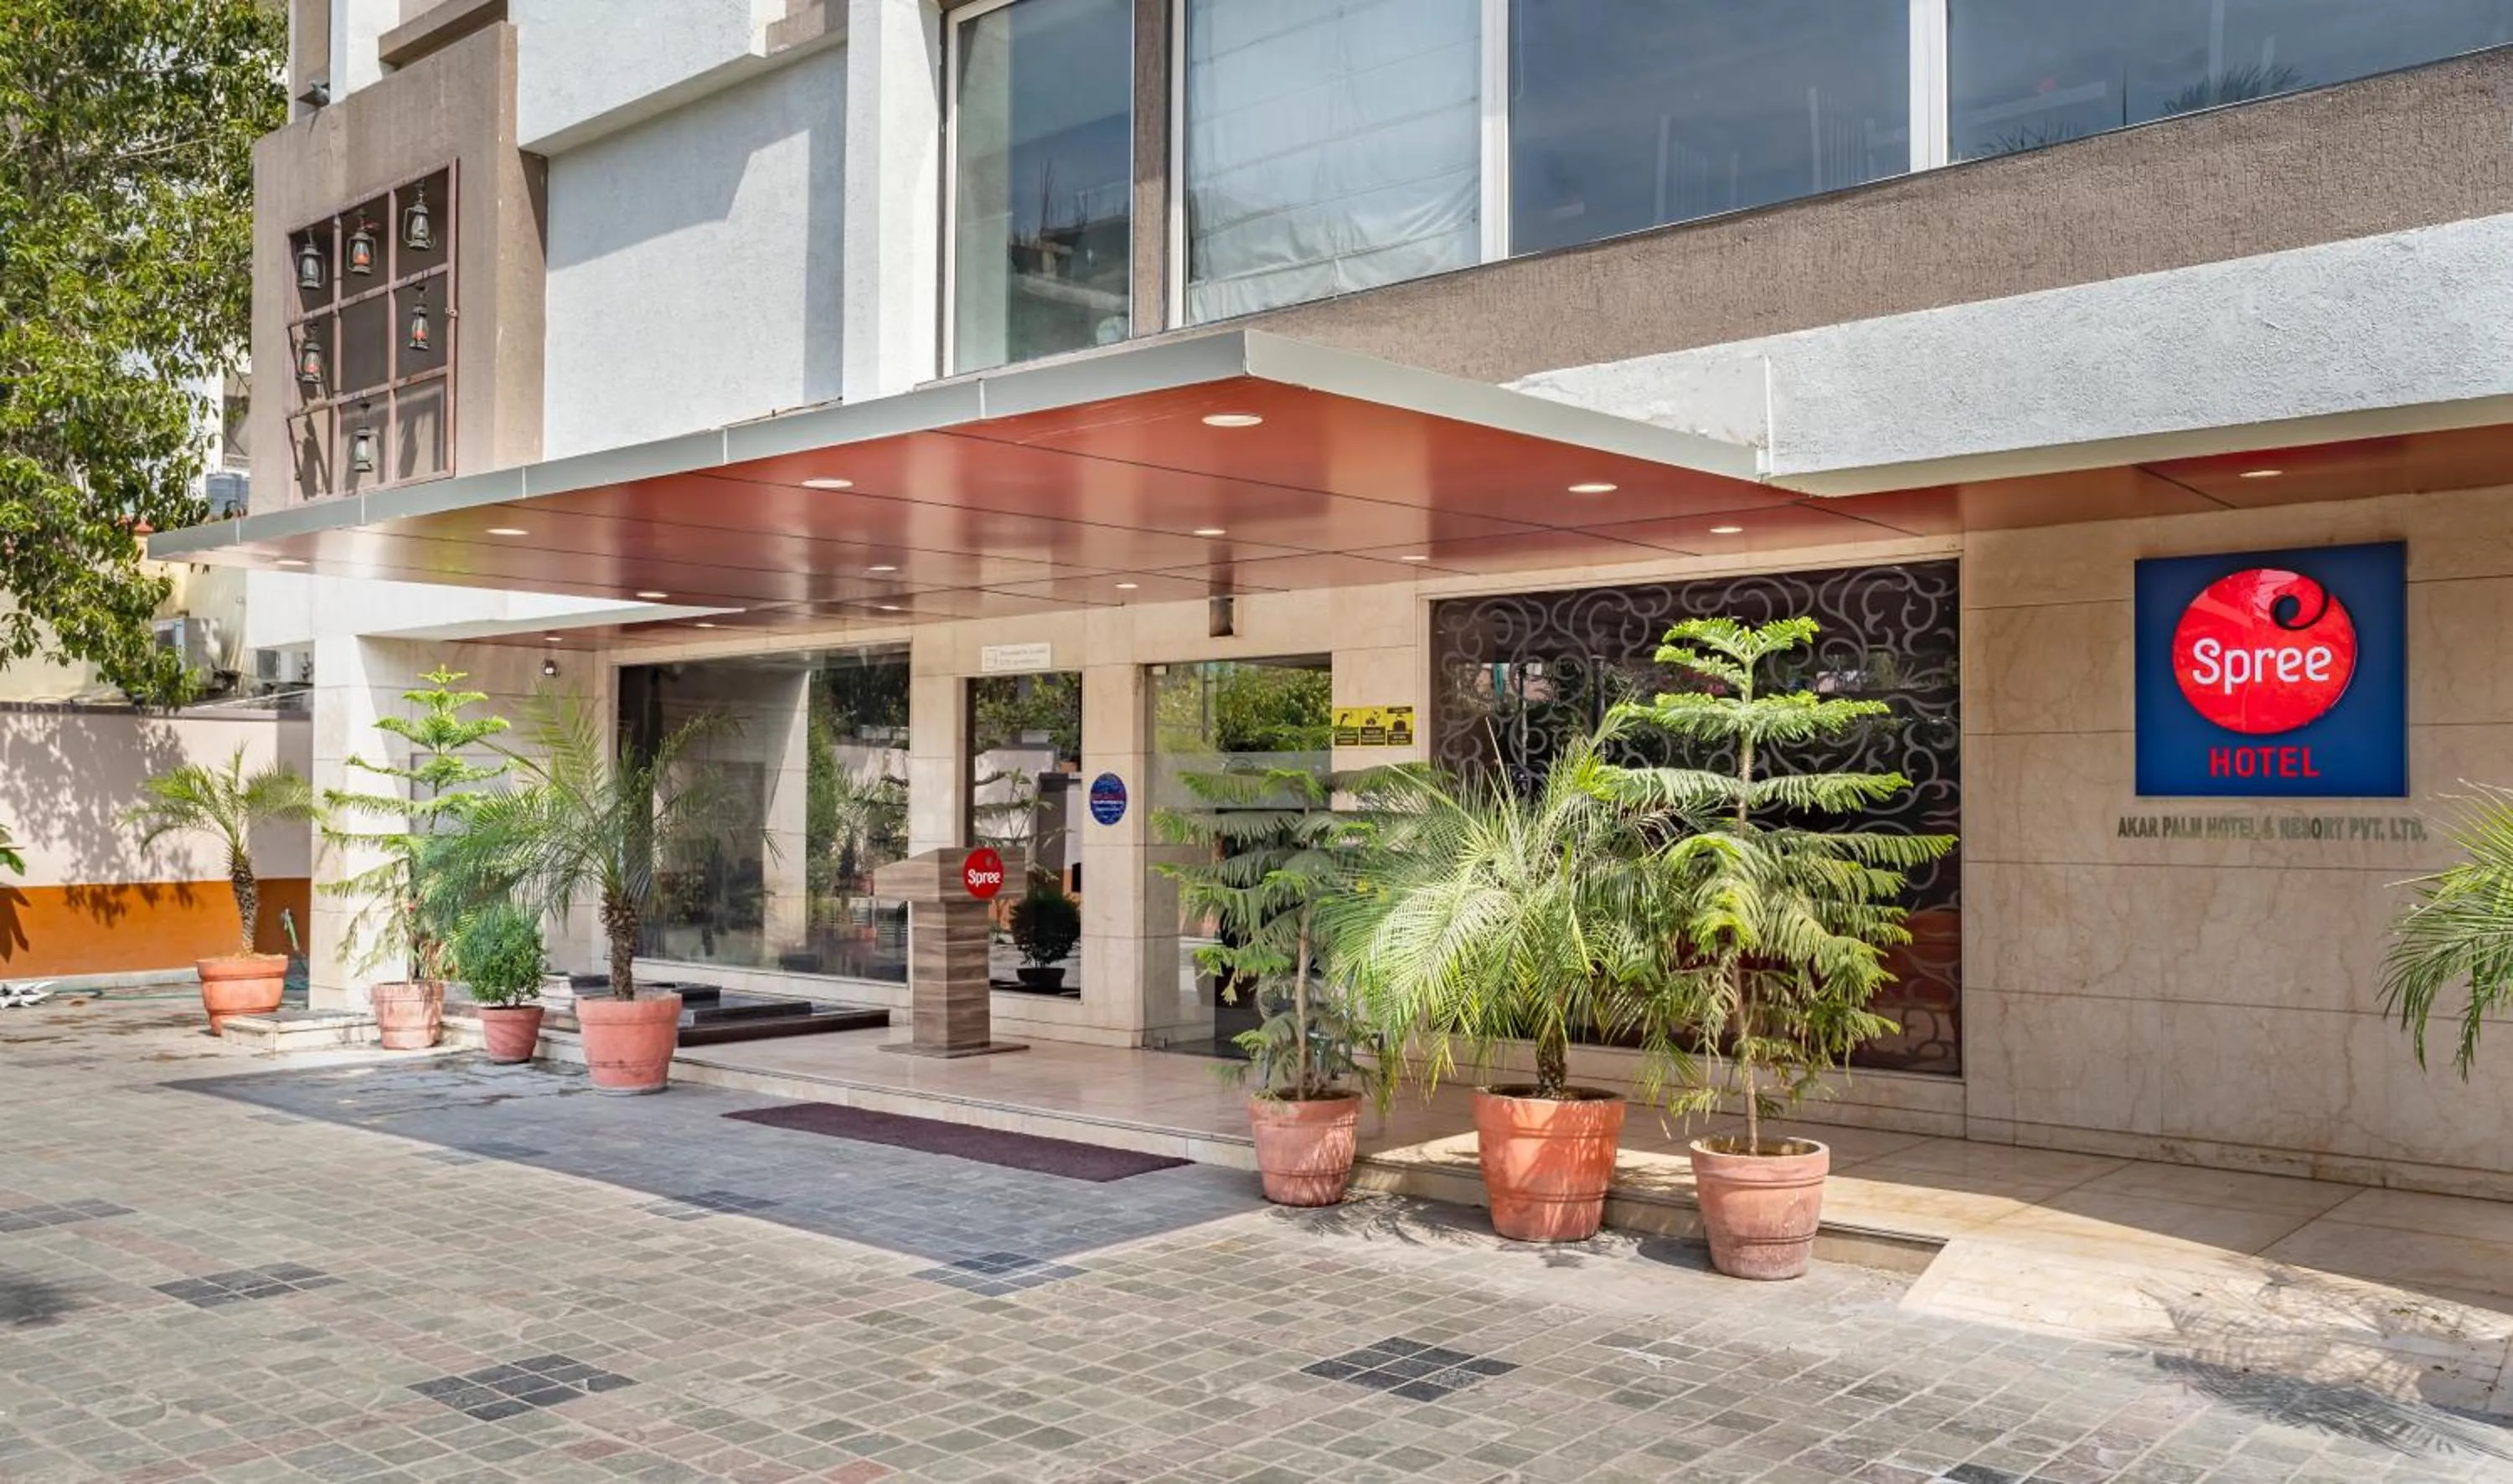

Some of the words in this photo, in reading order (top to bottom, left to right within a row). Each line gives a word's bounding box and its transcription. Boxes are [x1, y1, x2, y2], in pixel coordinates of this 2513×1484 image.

[2192, 637, 2332, 694] Spree
[2210, 745, 2320, 777] HOTEL
[2118, 816, 2158, 838] AKAR
[2163, 816, 2201, 838] PALM
[968, 868, 1001, 888] Spree
